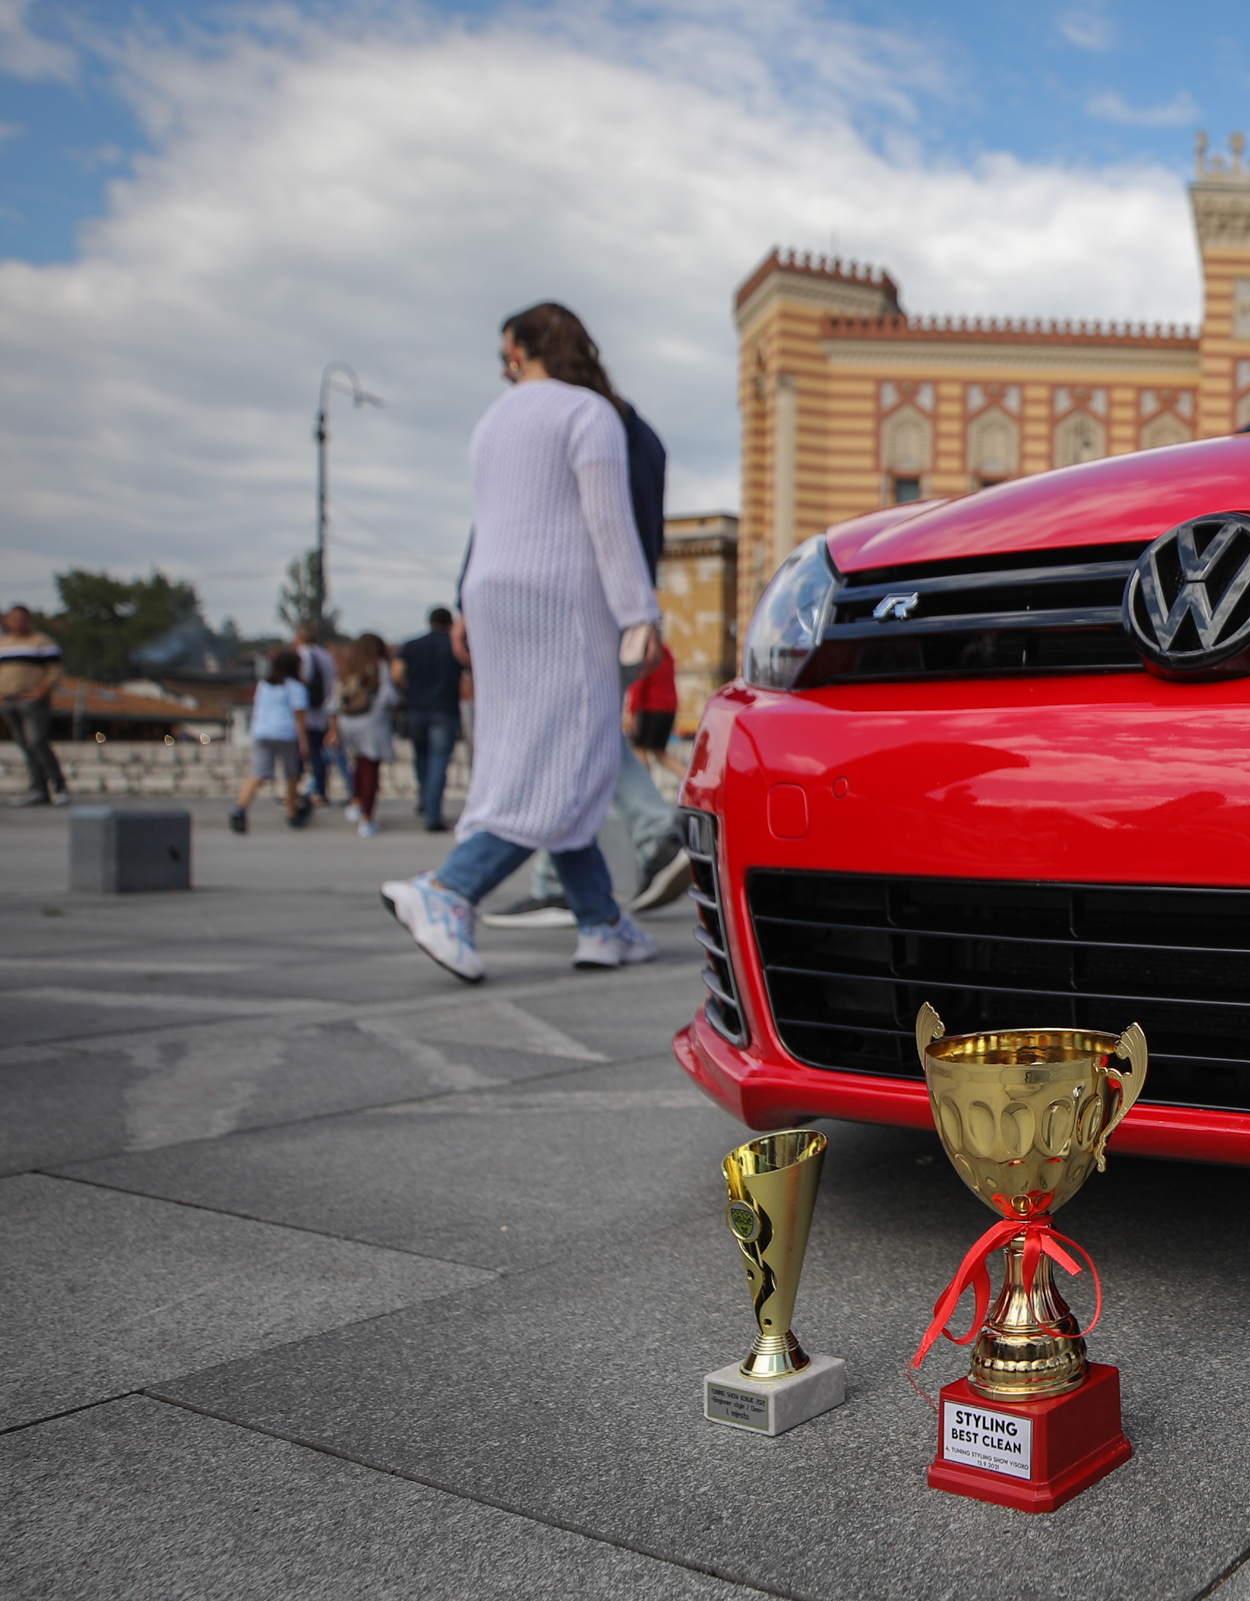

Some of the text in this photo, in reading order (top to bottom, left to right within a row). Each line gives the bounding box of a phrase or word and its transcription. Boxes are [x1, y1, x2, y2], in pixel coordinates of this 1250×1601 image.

[955, 1410, 1018, 1437] STYLING
[951, 1428, 1022, 1455] BEST CLEAN
[951, 1446, 971, 1457] TUNING
[971, 1451, 993, 1462] STYLING
[993, 1456, 1009, 1466] SHOW
[1009, 1460, 1029, 1471] VISOKO
